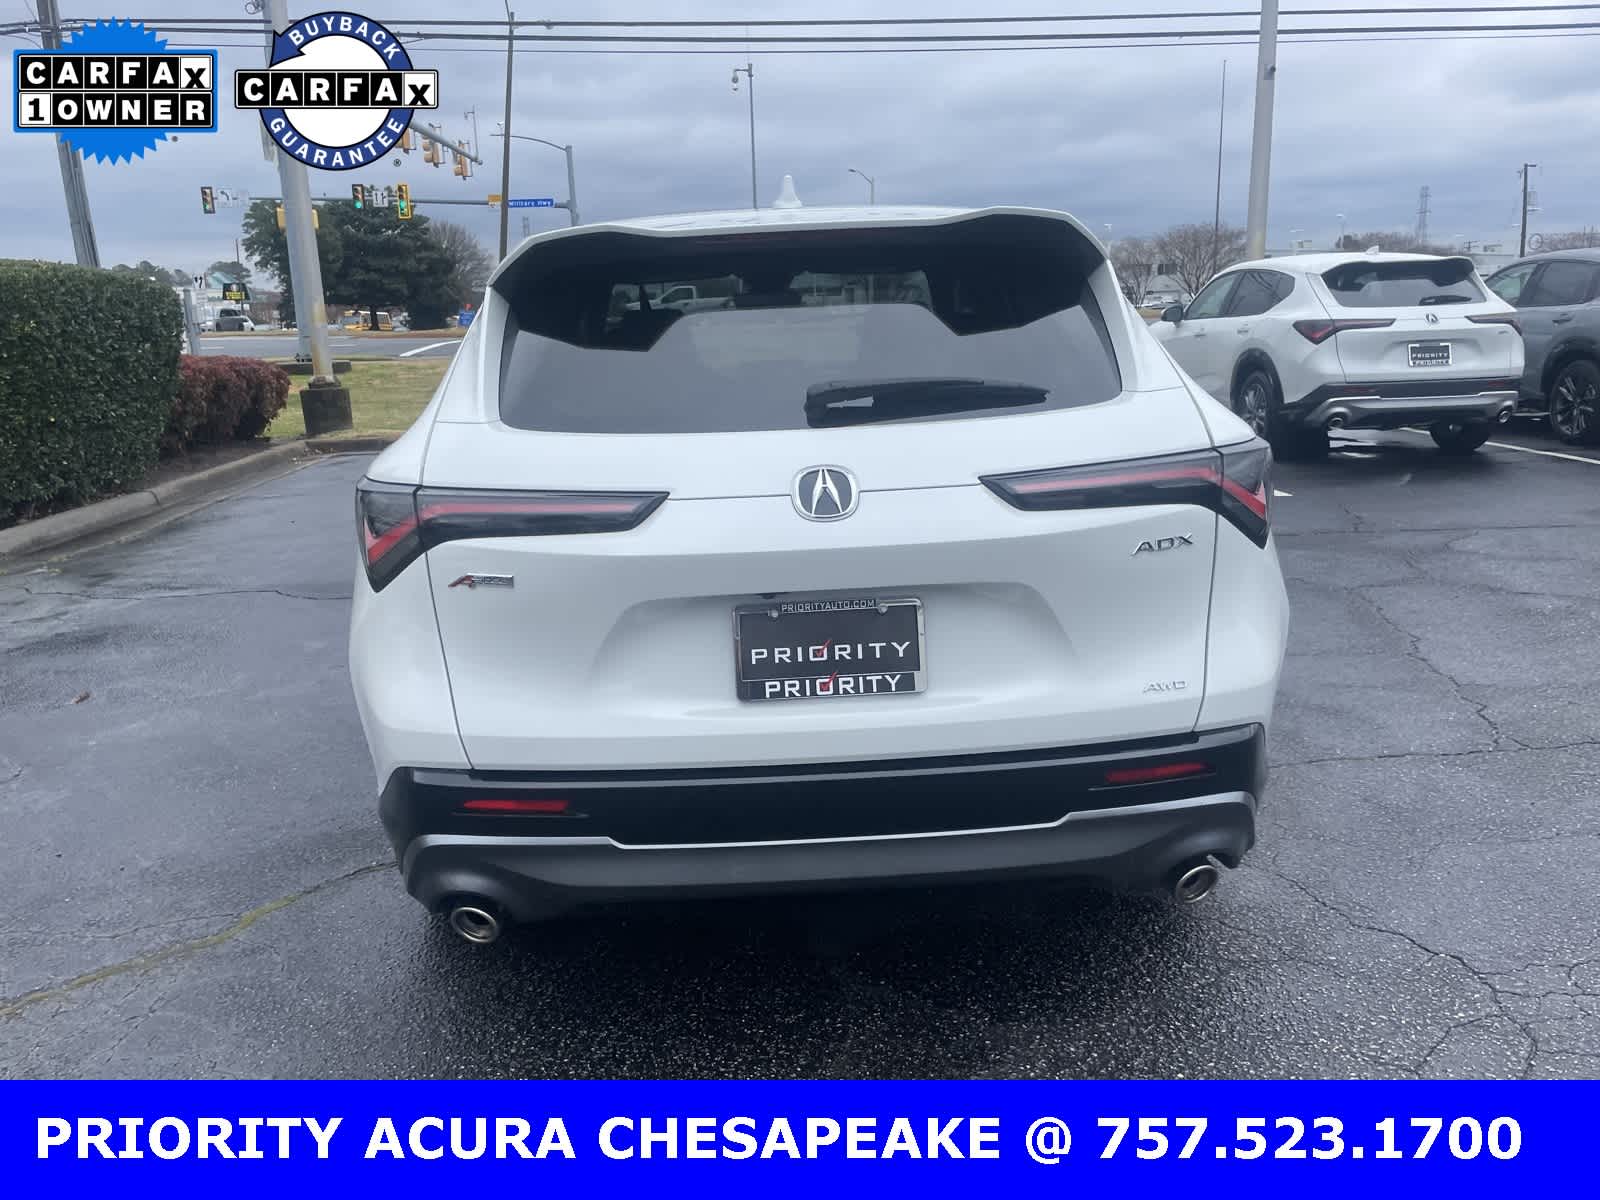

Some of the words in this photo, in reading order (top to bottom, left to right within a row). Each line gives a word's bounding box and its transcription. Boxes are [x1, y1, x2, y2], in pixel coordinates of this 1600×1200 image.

[1131, 533, 1193, 556] ADX
[781, 600, 875, 612] PRIORITYAUTO.COM
[751, 641, 911, 664] PRIORITY
[765, 674, 901, 698] PRIORITY
